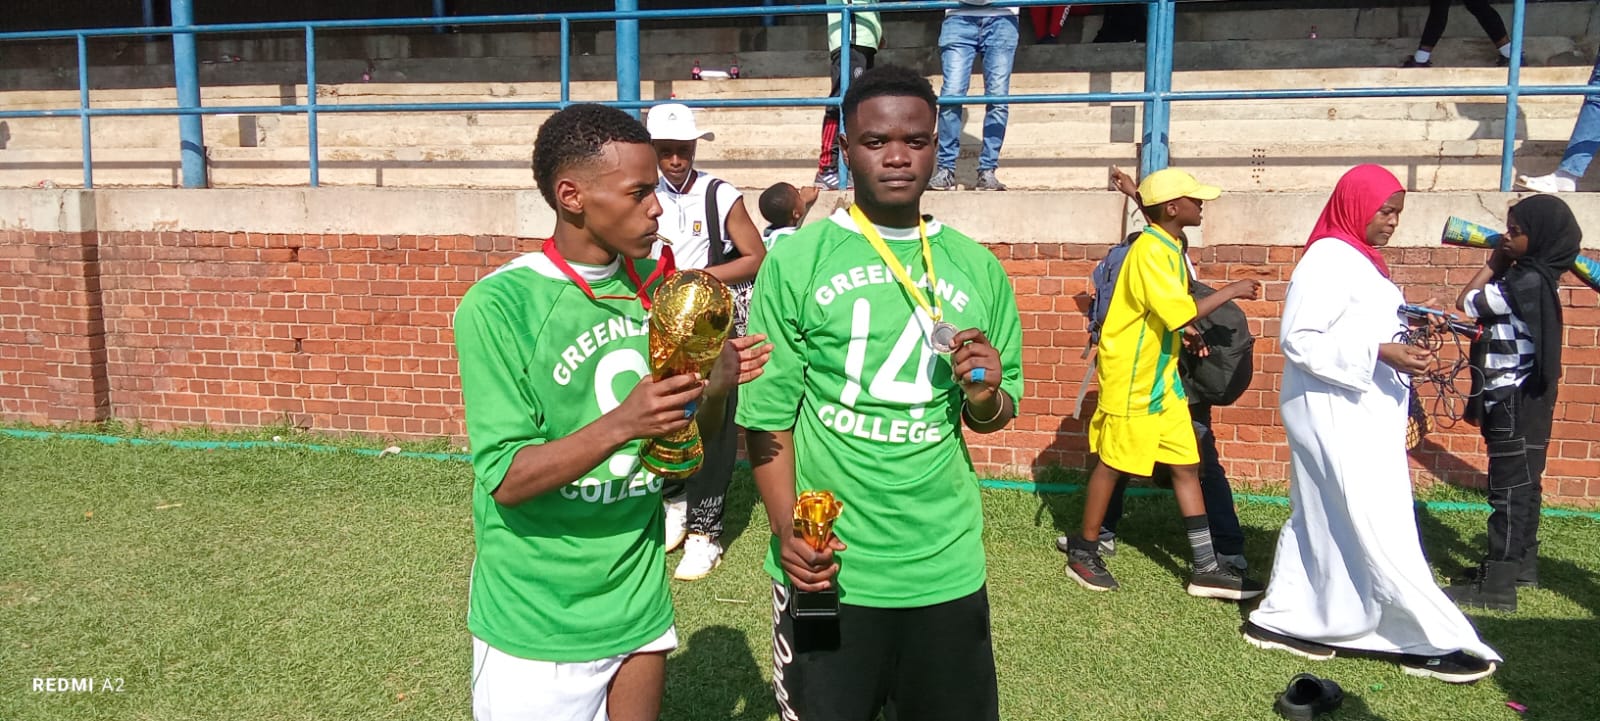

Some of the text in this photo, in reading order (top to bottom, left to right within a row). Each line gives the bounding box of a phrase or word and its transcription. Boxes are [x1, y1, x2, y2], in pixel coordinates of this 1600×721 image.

[552, 312, 651, 386] GREENL
[840, 297, 934, 419] 14
[817, 404, 943, 443] COLLEGE
[560, 471, 665, 505] COLLEG
